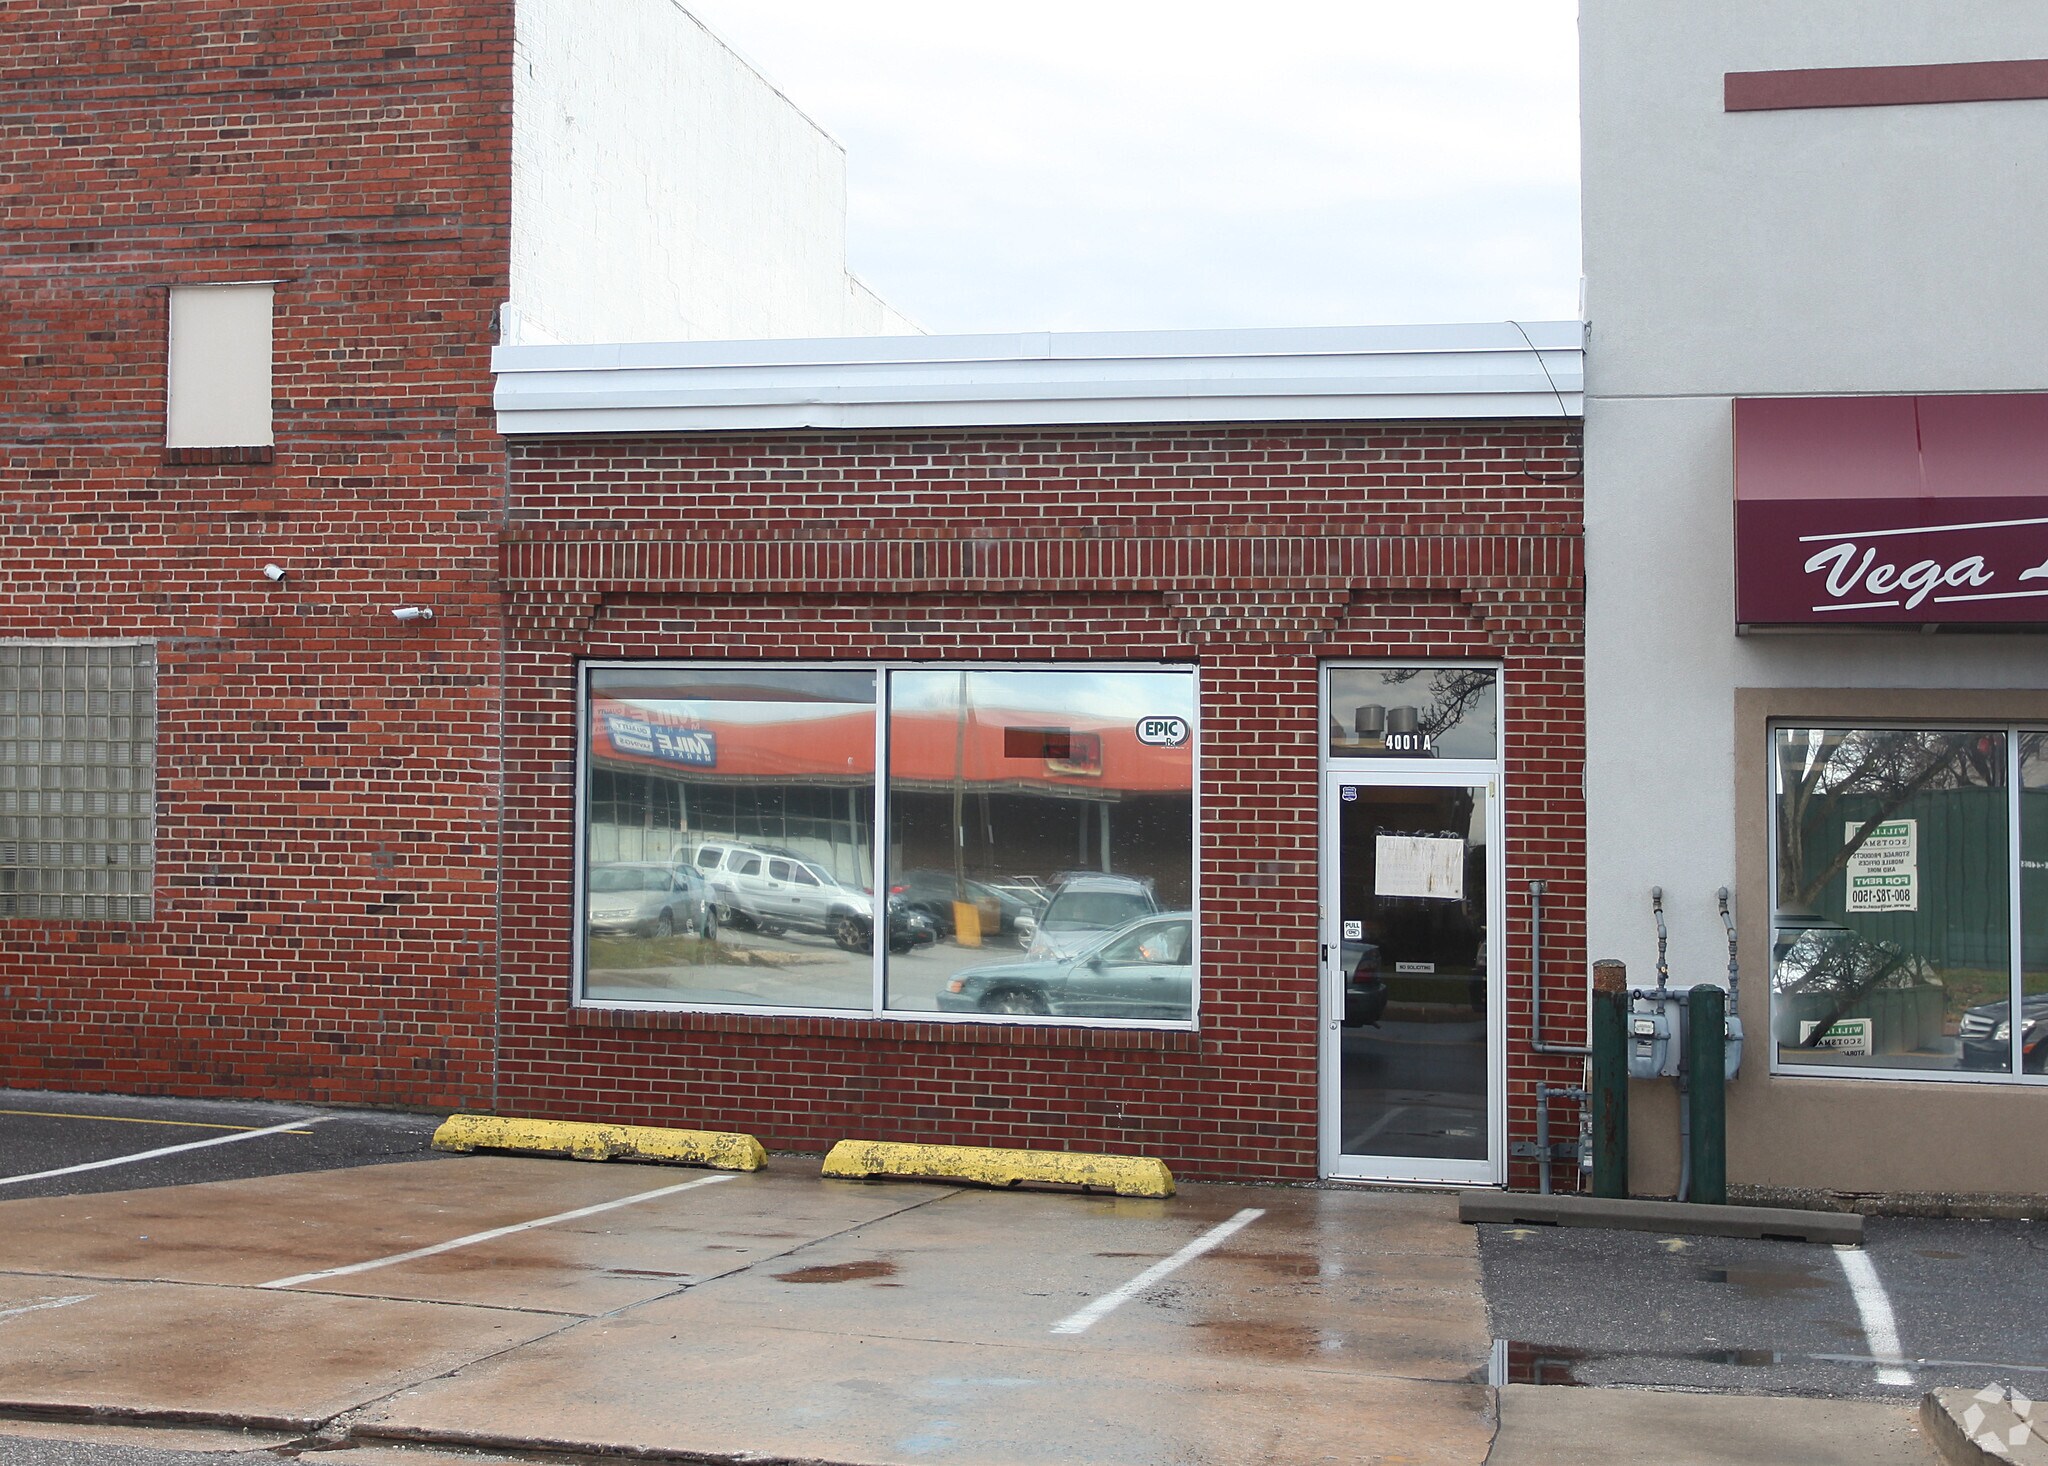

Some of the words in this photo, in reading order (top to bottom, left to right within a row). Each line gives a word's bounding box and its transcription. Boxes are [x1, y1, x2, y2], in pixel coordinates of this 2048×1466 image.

[1804, 542, 1995, 610] Vega
[1146, 721, 1177, 736] EPIC
[1386, 734, 1418, 750] 4001
[1423, 735, 1431, 750] A
